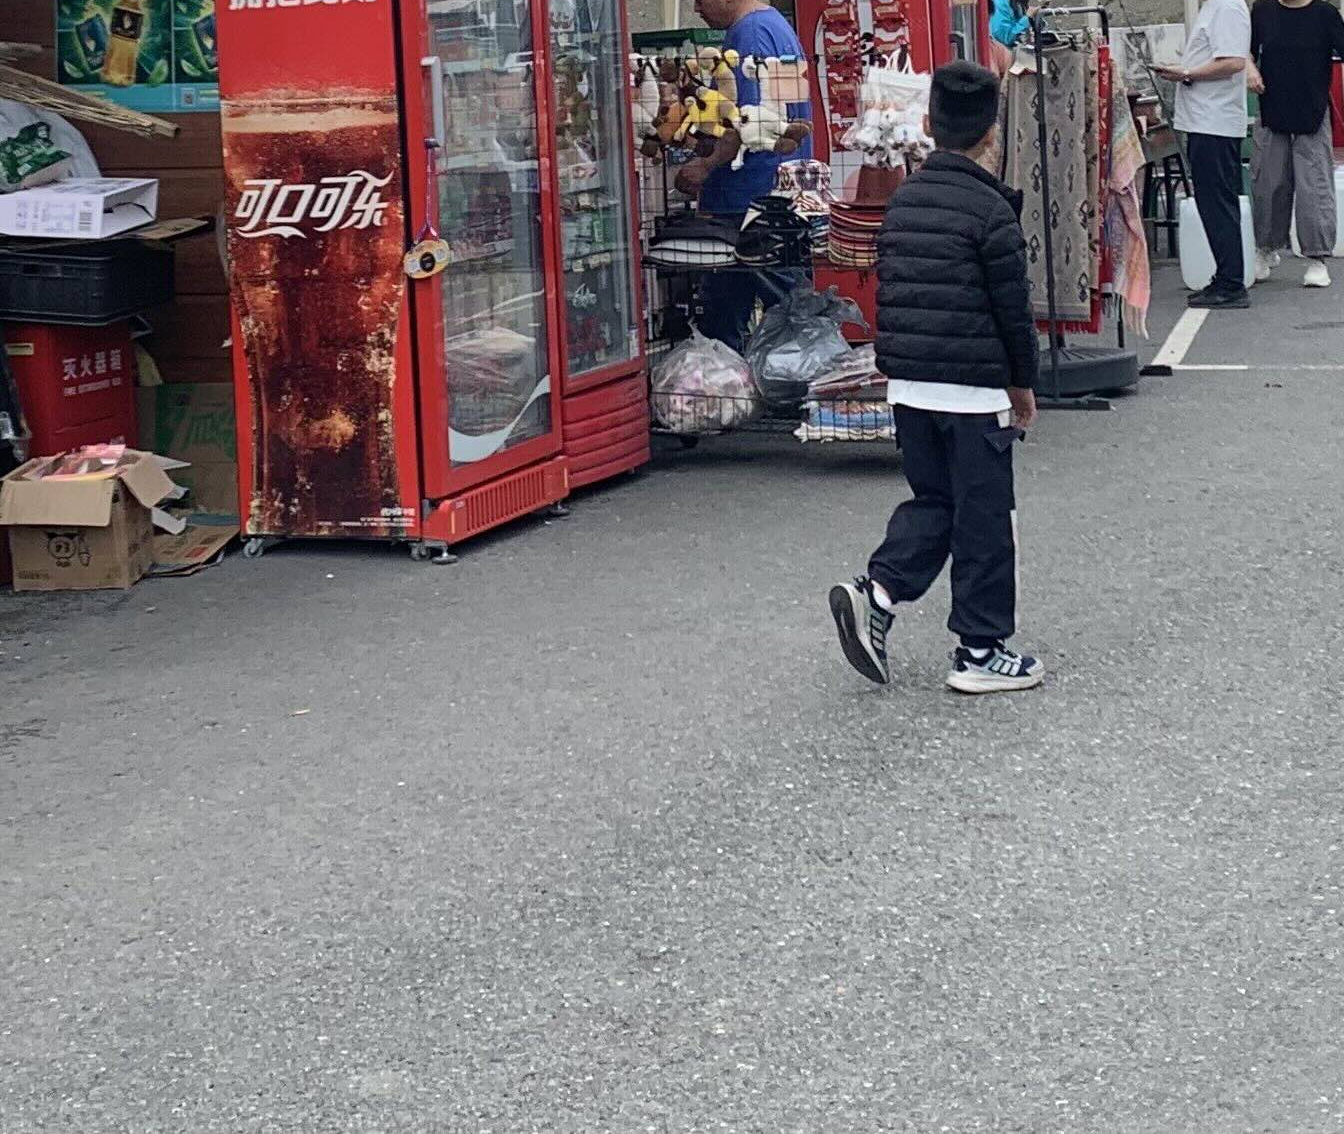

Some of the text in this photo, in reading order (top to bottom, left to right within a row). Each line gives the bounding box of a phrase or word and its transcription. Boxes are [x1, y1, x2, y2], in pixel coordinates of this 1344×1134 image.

[234, 170, 394, 238] 可口可乐
[62, 349, 121, 380] 灭火器箱
